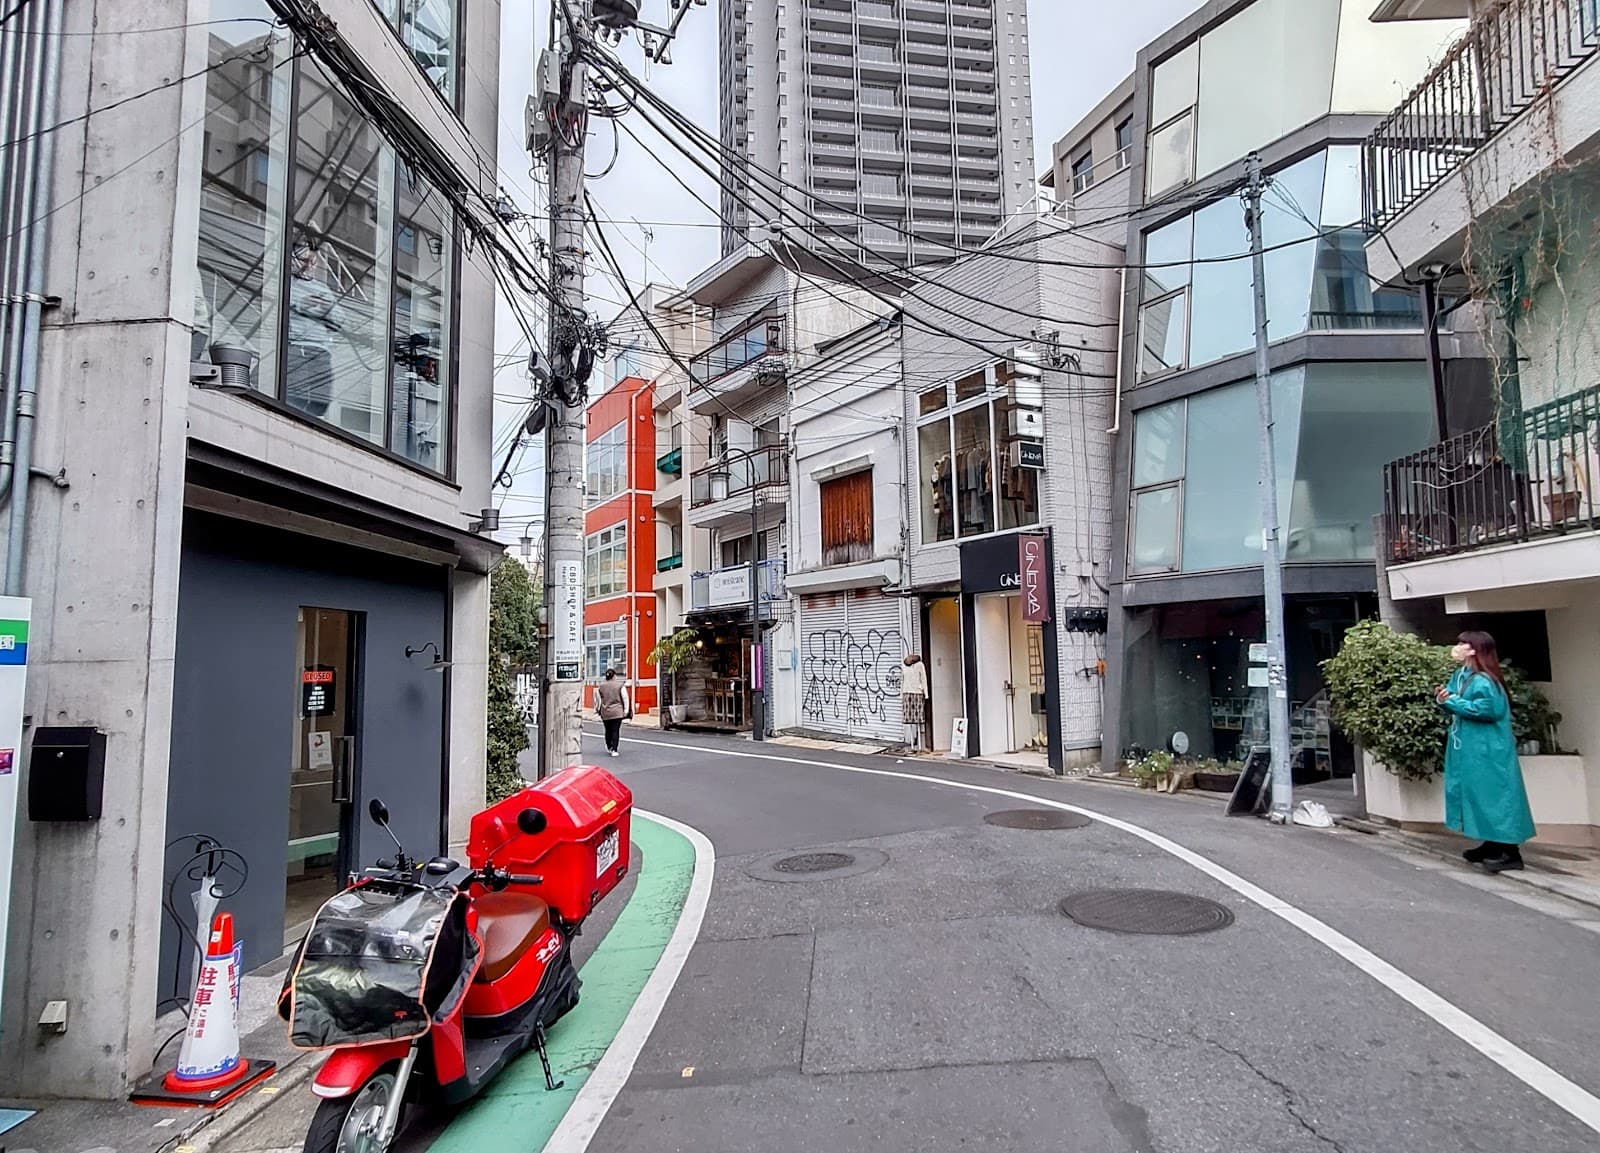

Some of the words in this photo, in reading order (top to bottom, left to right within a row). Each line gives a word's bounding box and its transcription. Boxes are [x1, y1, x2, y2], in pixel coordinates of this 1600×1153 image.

[569, 566, 577, 583] CBD
[569, 586, 577, 610] SHOP
[569, 620, 577, 643] CAFE
[304, 672, 332, 681] CLOSED
